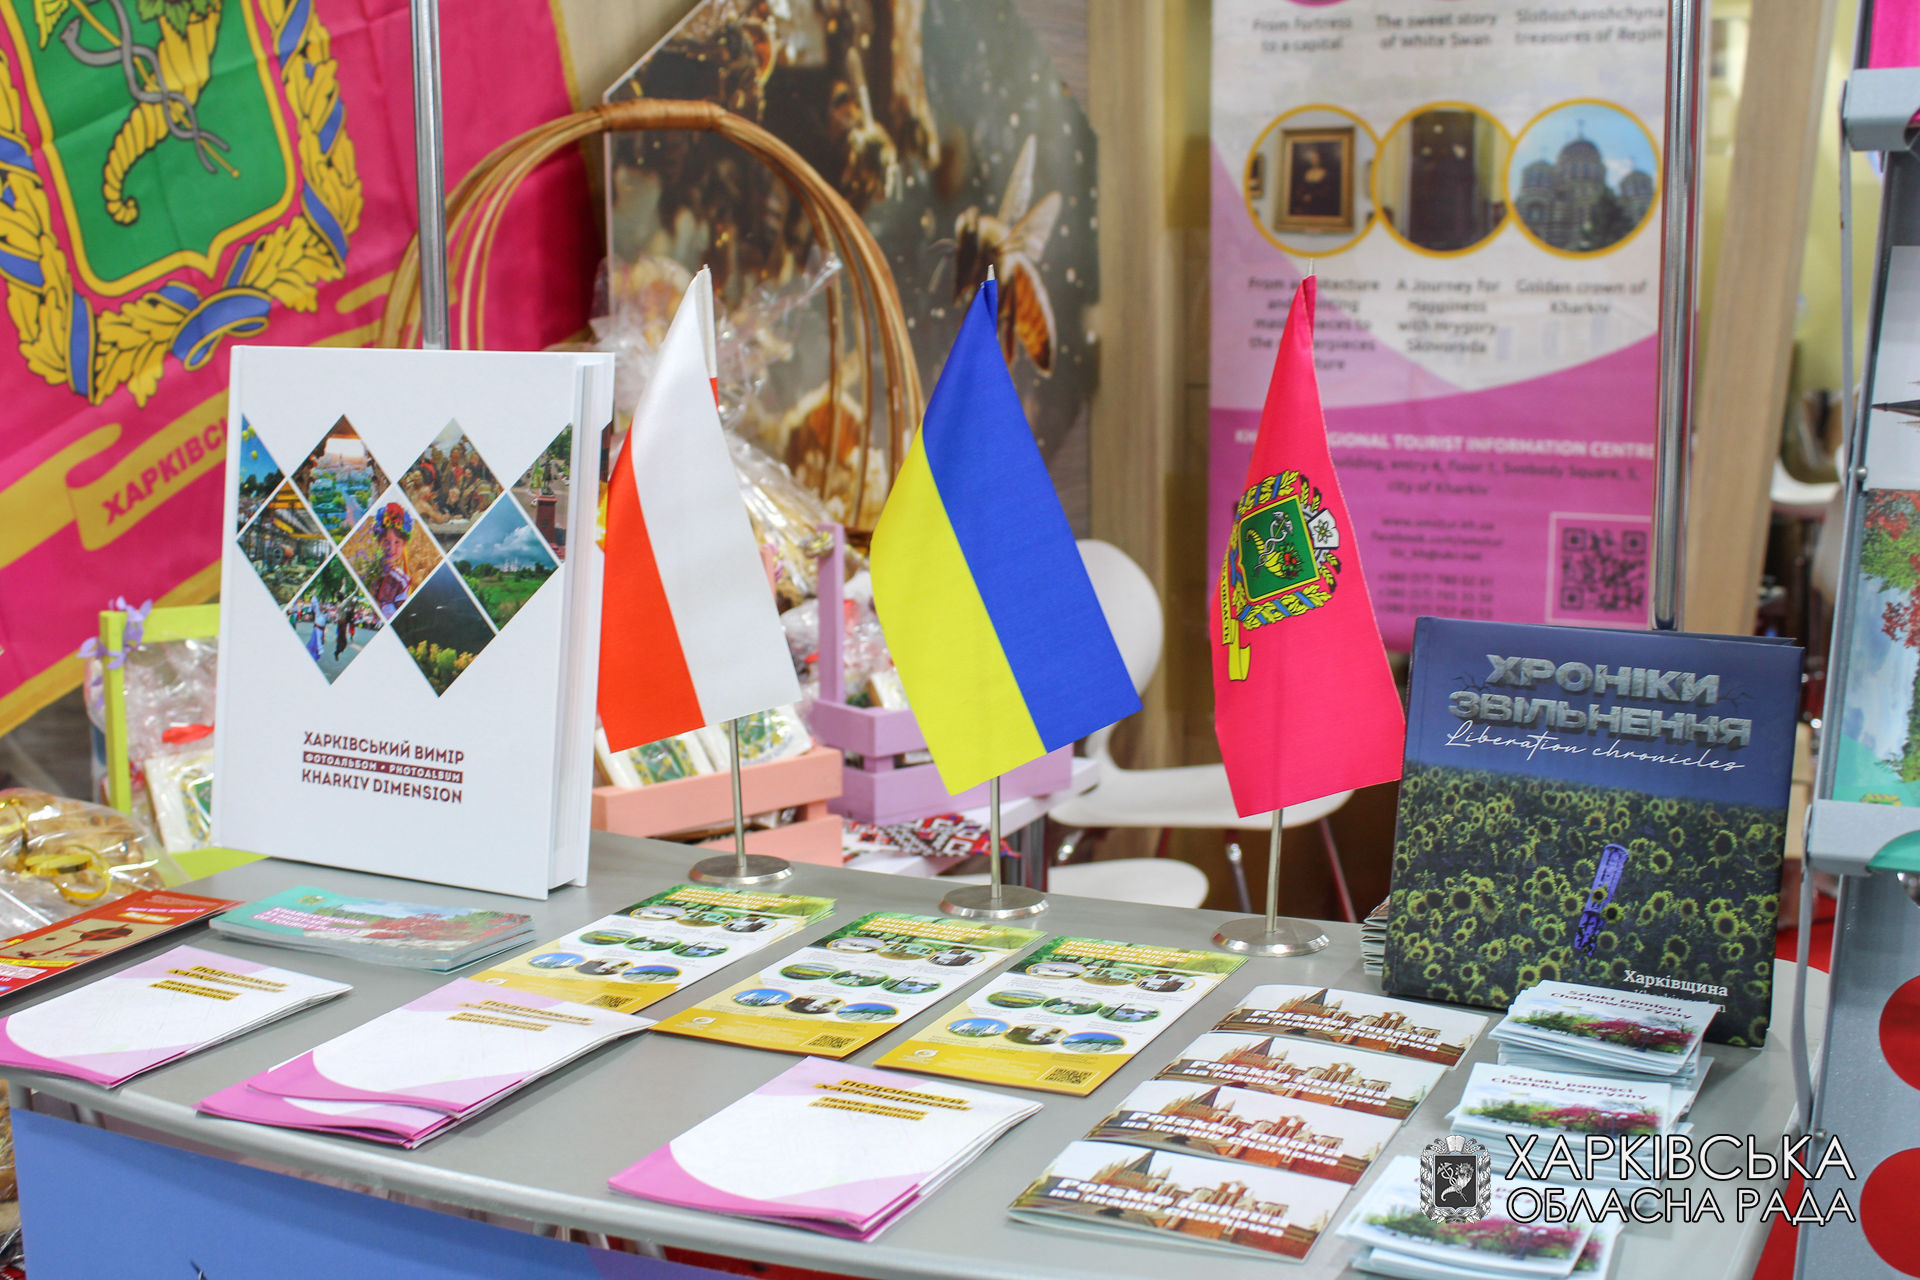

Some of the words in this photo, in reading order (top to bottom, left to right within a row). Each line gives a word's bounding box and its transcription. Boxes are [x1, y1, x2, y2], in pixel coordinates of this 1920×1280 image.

[1394, 434, 1464, 452] TOURIST
[1465, 436, 1587, 457] INFORMATION
[1486, 654, 1720, 705] ХРОНІКИ
[1448, 690, 1753, 747] ЗВІЛЬНЕННЯ
[303, 731, 411, 758] ХАРКІВСЬКИЙ
[414, 745, 464, 765] ВИМІР
[1445, 720, 1586, 761] Liberation
[1591, 739, 1745, 772] chronicles
[304, 752, 377, 771] ФОТОАЛЬБОМ
[388, 763, 461, 783] PHOTOALBUM
[302, 768, 369, 791] KHARKIV
[373, 778, 462, 804] DIMENSION
[1624, 970, 1728, 997] Харківщина
